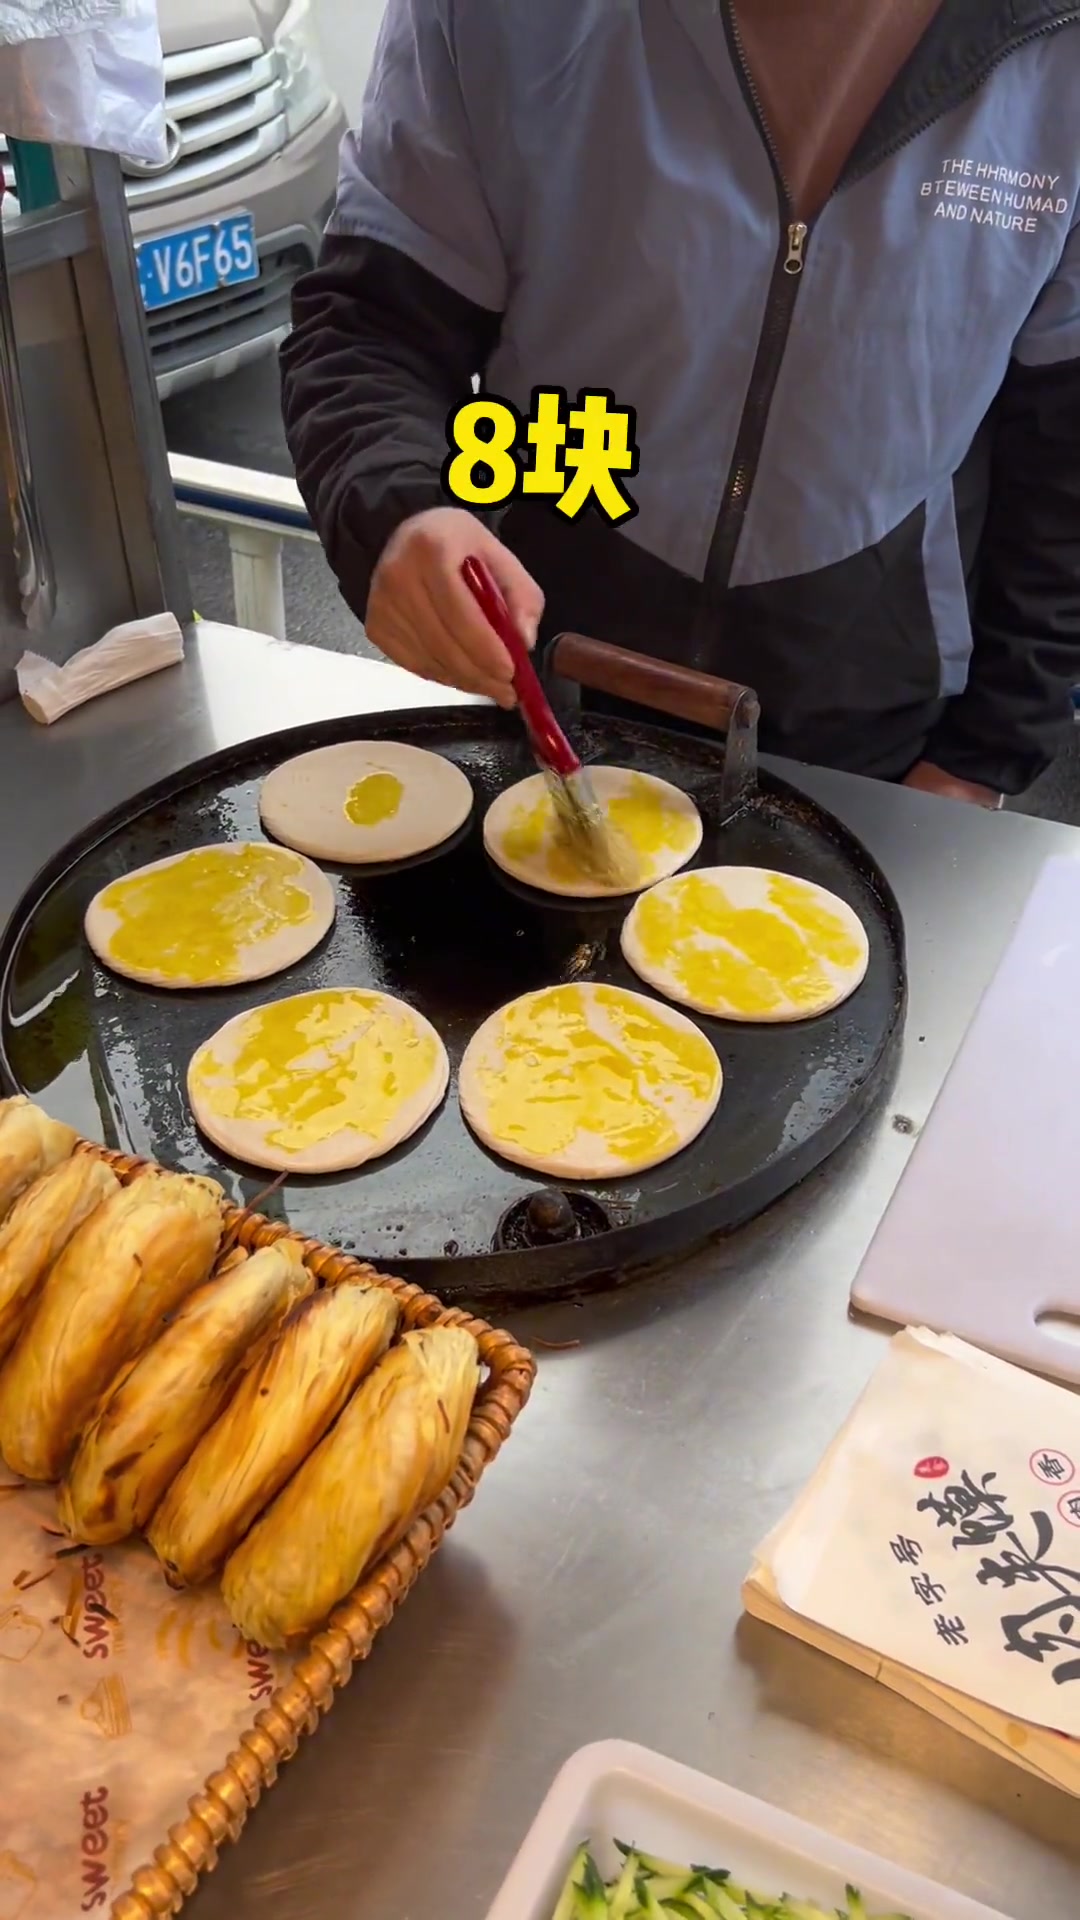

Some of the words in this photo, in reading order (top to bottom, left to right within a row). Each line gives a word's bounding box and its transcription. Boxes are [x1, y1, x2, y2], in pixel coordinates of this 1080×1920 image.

[942, 158, 974, 176] THE
[934, 201, 967, 221] AND
[970, 207, 1037, 233] NATURE
[82, 1553, 109, 1659] sweet
[889, 1534, 970, 1646] 老字号
[247, 1640, 274, 1701] swe
[80, 1786, 110, 1912] sweet
